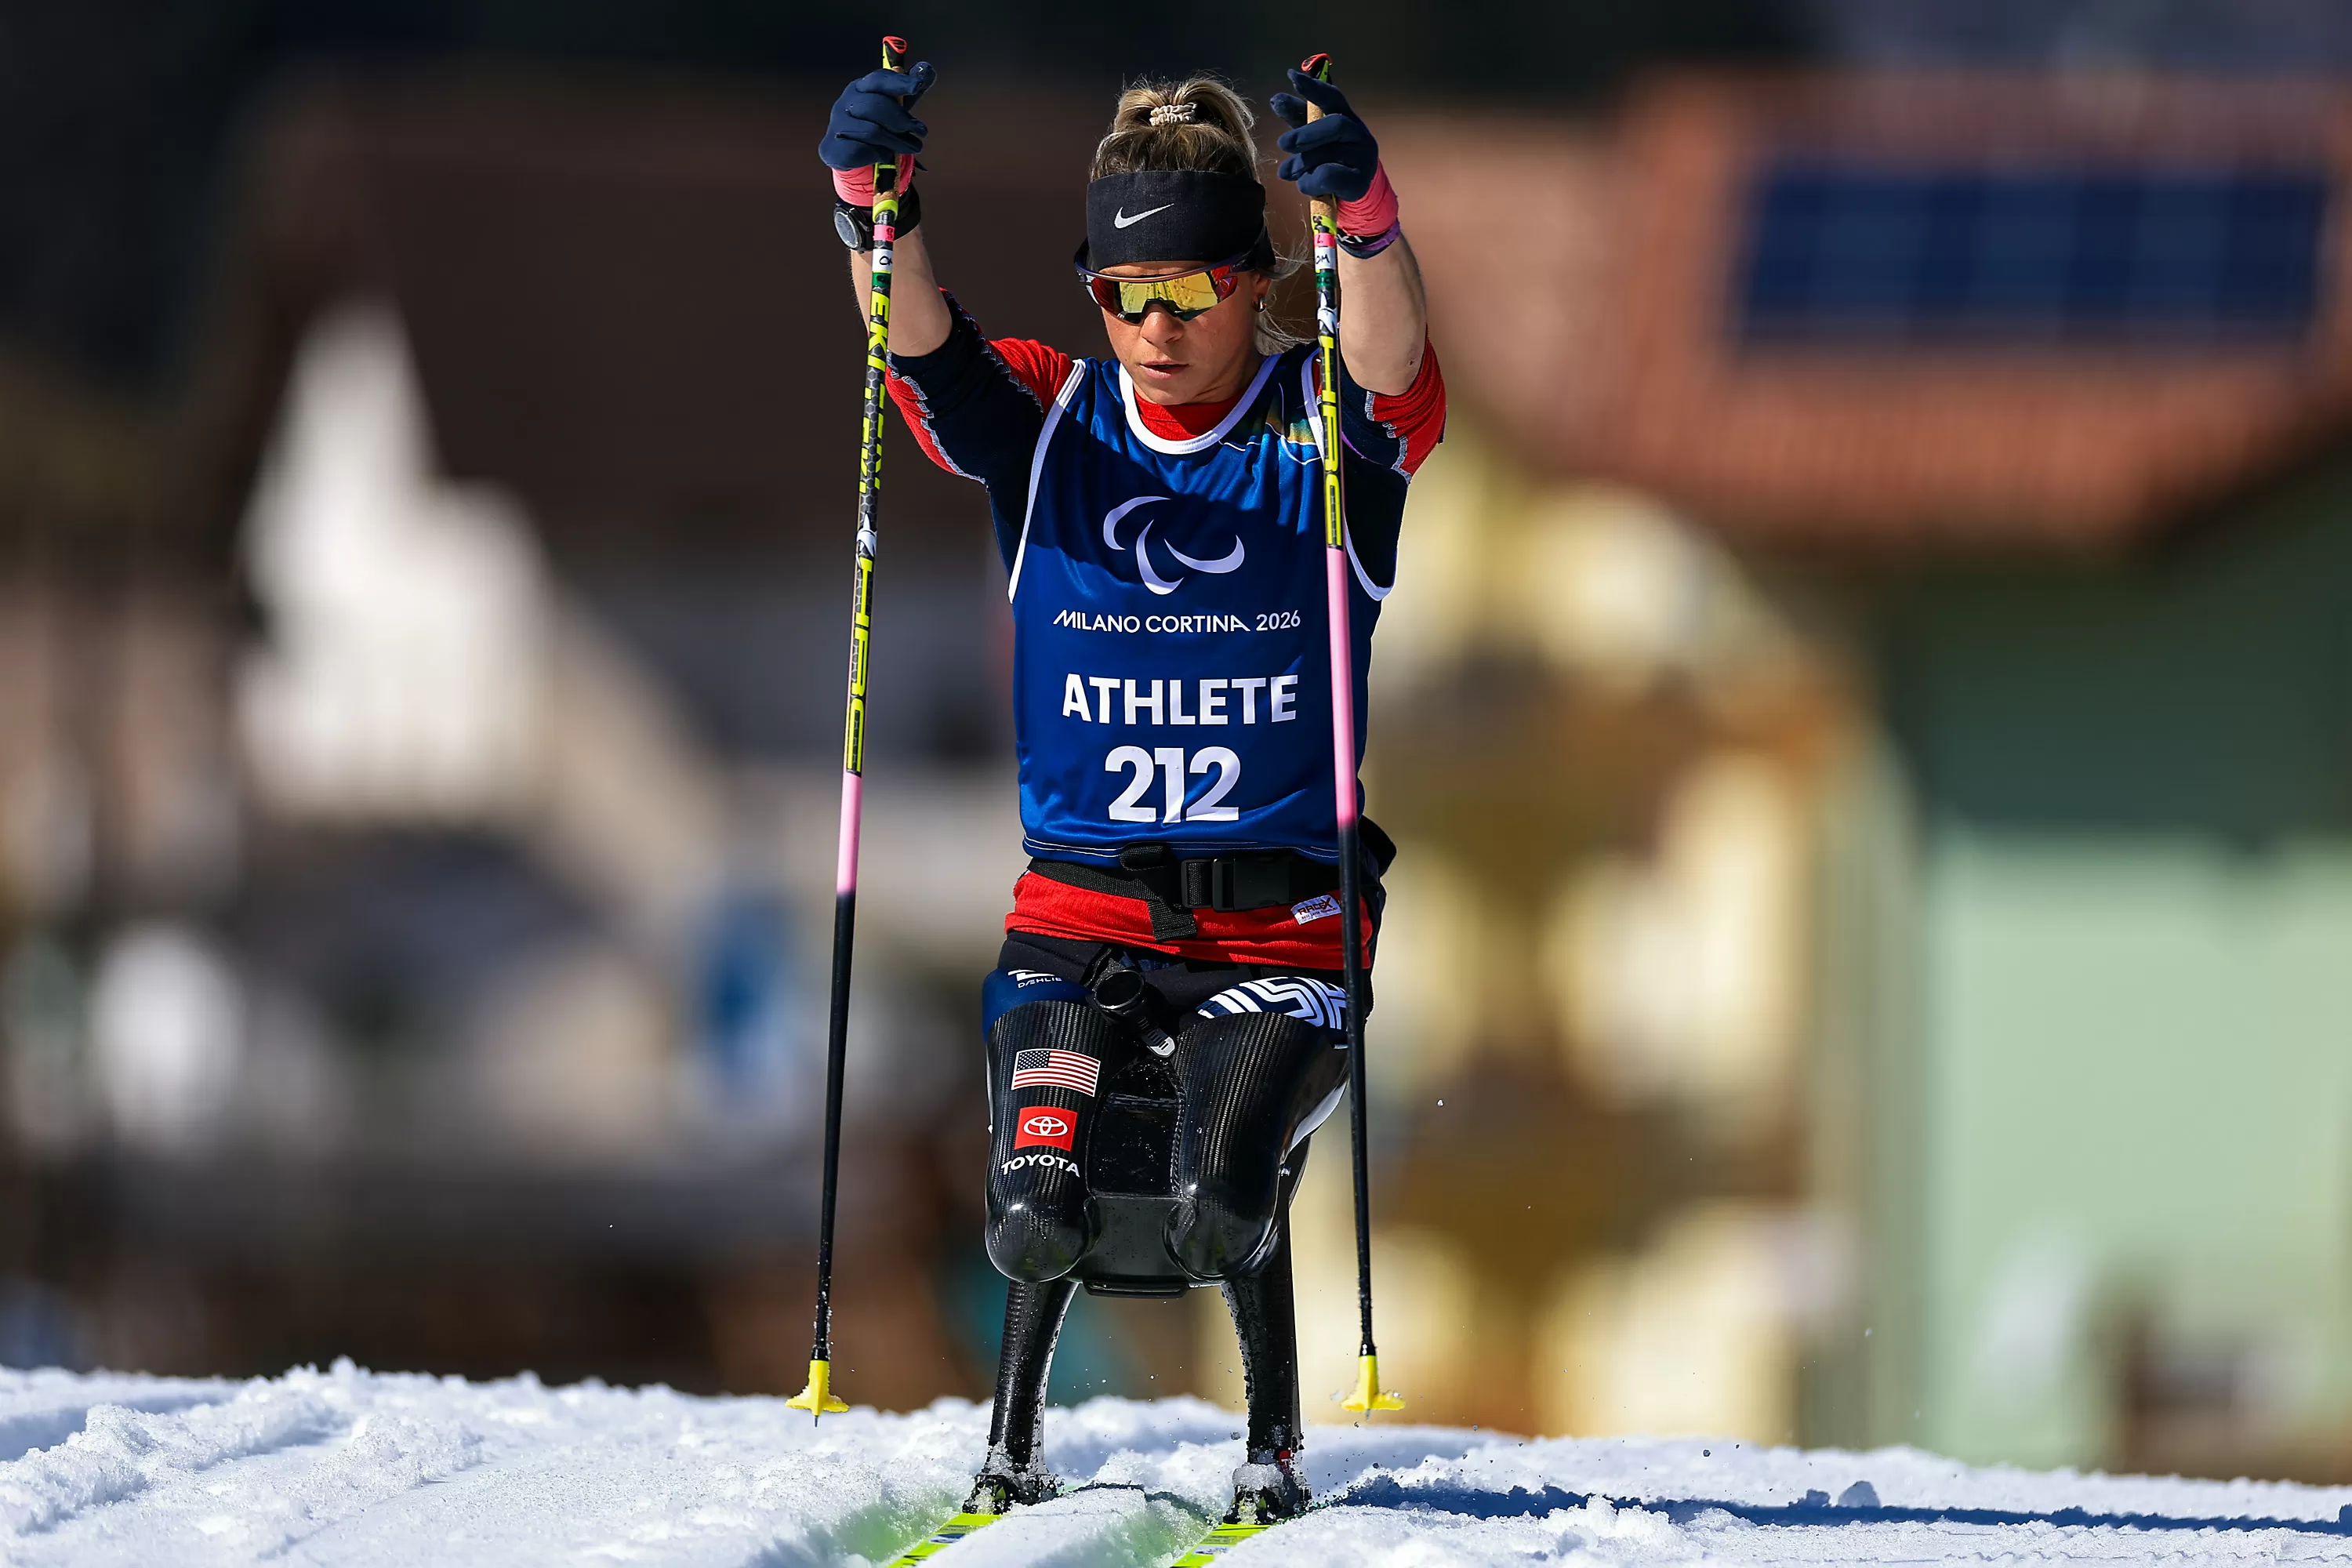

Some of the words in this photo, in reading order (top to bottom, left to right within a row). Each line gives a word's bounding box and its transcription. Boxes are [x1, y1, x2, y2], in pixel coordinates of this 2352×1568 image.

[1053, 609, 1141, 633] MILANO
[1145, 615, 1251, 633] CORTINA
[1256, 609, 1301, 632] 2026
[1062, 673, 1298, 725] ATHLETE
[1105, 746, 1241, 825] 212
[1001, 1154, 1080, 1178] TOYOTA
